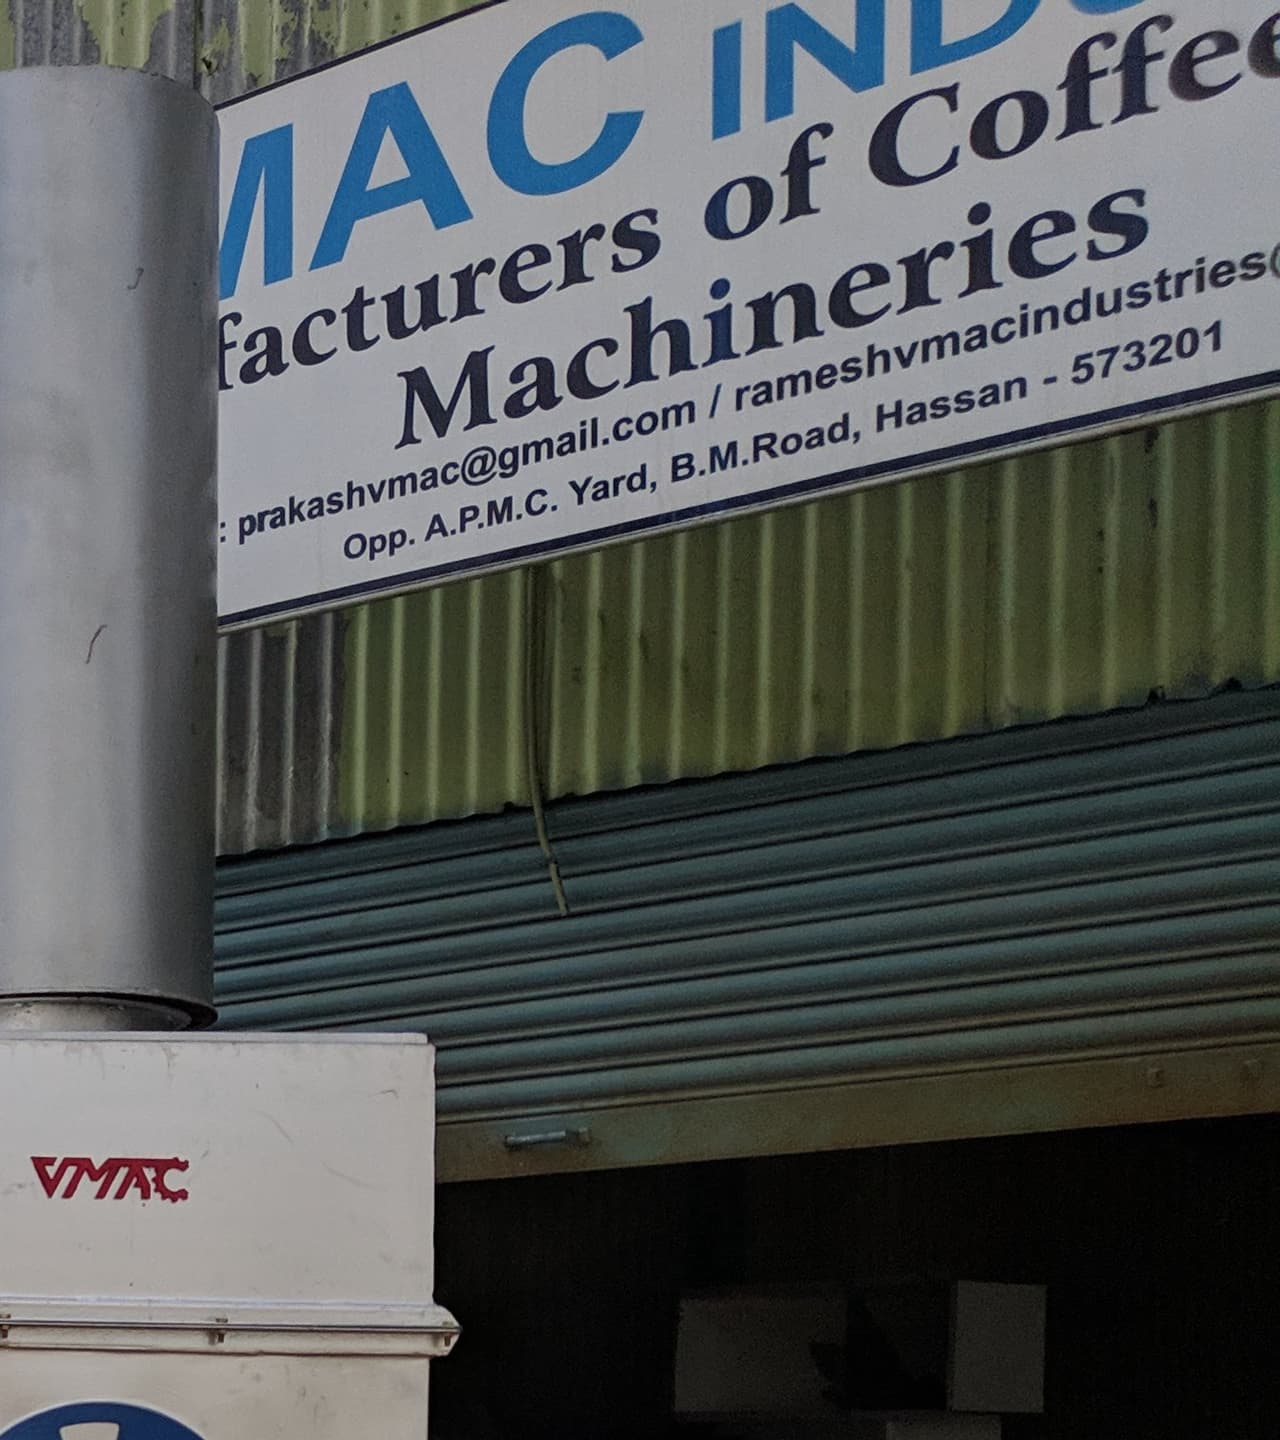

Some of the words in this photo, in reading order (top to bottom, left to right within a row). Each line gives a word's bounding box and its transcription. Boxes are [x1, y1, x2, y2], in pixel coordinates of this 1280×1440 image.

[712, 0, 1145, 140] IND
[704, 122, 834, 240] of
[239, 400, 696, 545] prakashvmac@gmail.com
[709, 383, 723, 419] /
[736, 243, 1280, 411] rameshvmacindustries
[394, 189, 1150, 450] Machineries
[344, 529, 416, 561] Opp.
[425, 489, 557, 541] A.P.M.C.
[568, 463, 657, 506] Yard,
[671, 412, 861, 483] B.M.Road,
[877, 376, 1028, 432] Hassan
[1071, 320, 1222, 384] 573201
[30, 1156, 189, 1203] VMAC
